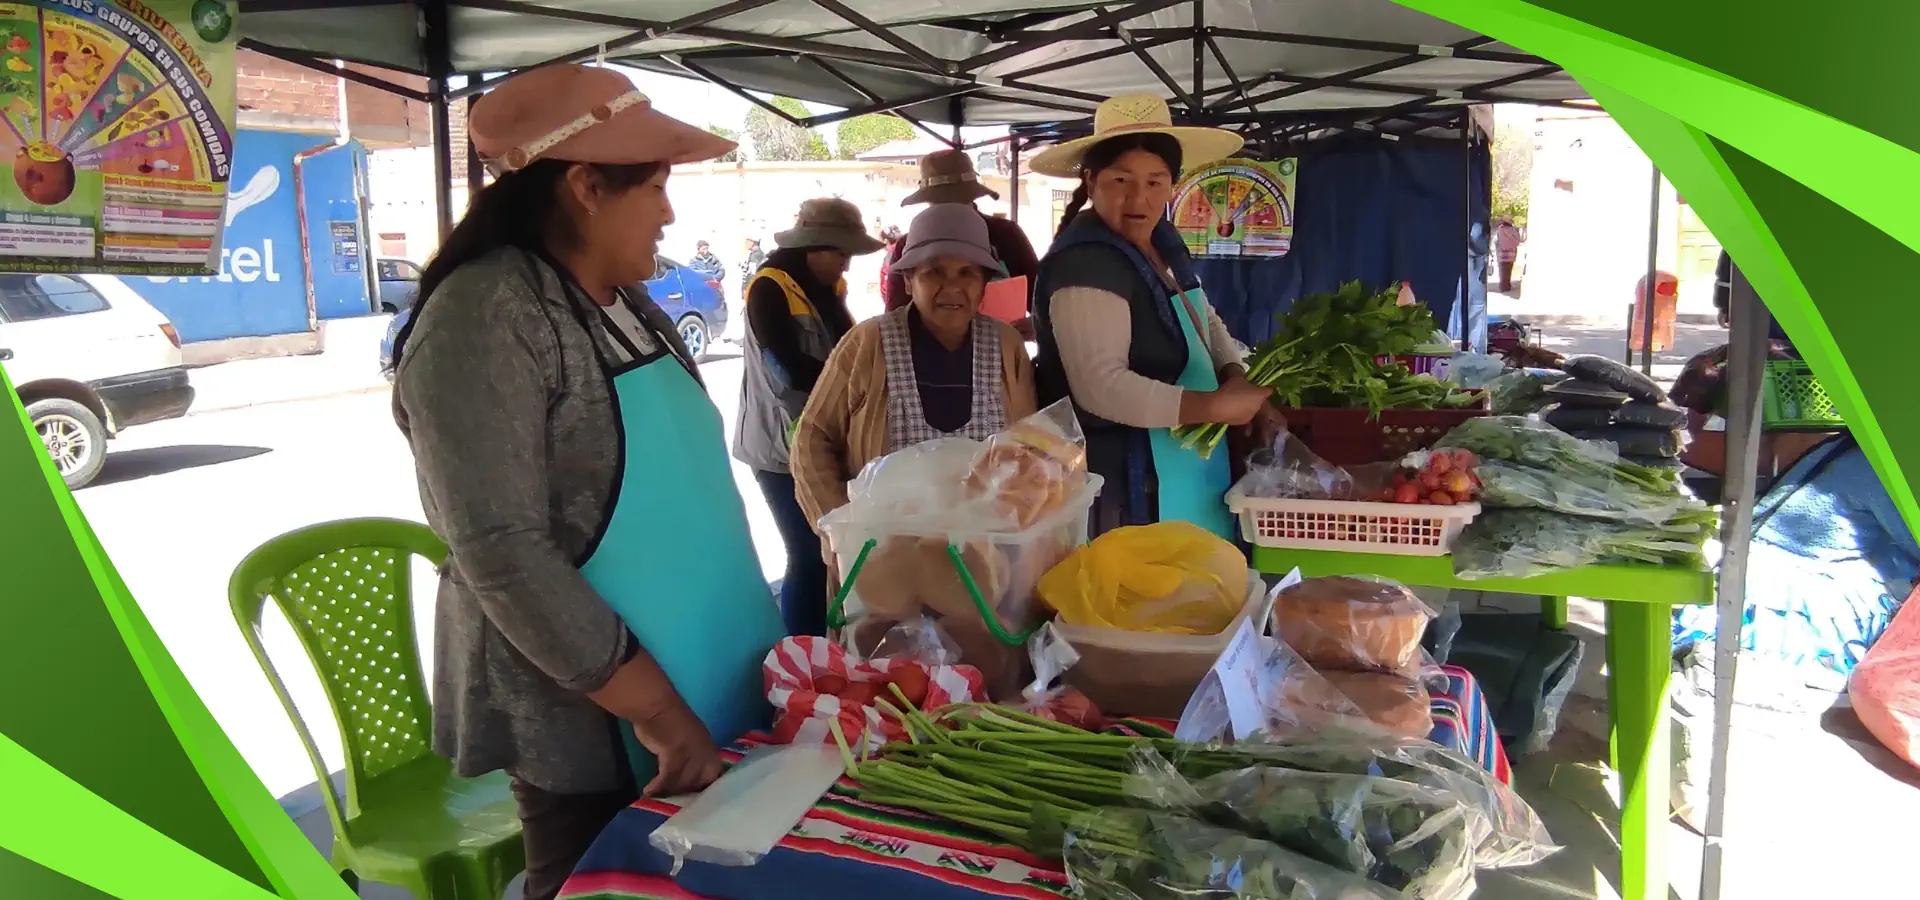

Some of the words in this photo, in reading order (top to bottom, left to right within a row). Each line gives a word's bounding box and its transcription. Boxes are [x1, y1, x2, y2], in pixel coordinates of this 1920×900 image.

[97, 7, 158, 53] GRUPOS
[155, 48, 174, 69] EN
[169, 67, 194, 99] SUS
[189, 99, 229, 176] COMIDAS
